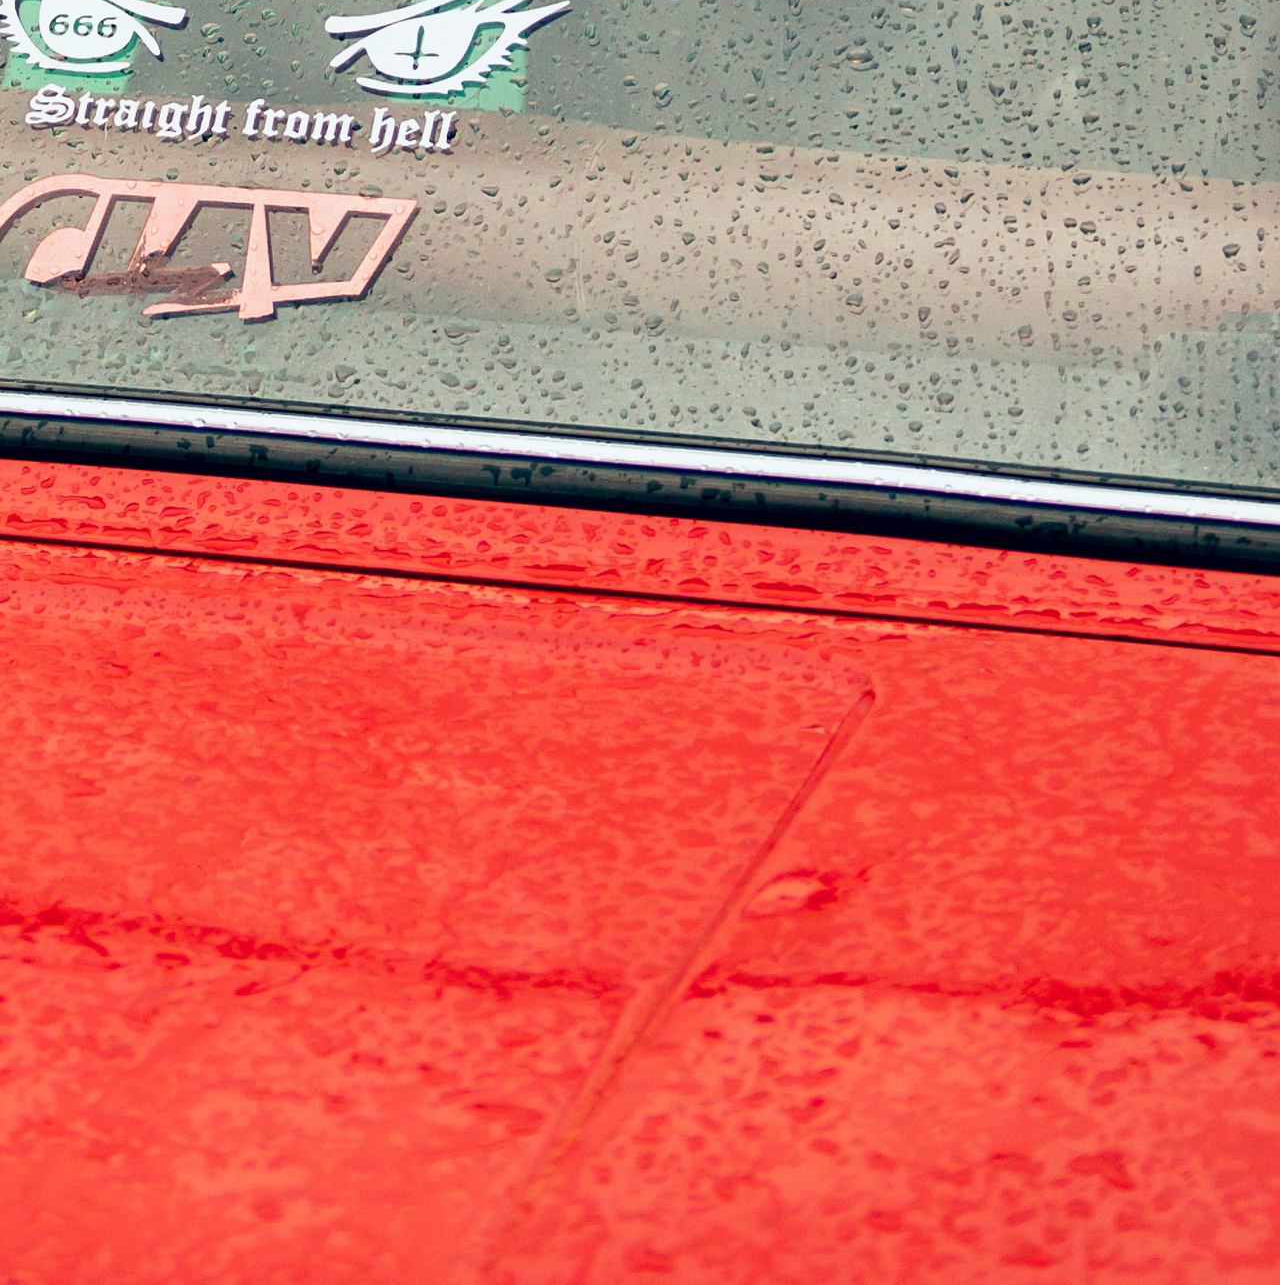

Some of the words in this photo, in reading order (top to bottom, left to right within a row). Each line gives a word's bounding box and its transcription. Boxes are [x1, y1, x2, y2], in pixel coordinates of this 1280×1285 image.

[48, 13, 118, 38] 666
[24, 83, 231, 142] Straight
[241, 98, 355, 143] from
[368, 106, 458, 153] hell
